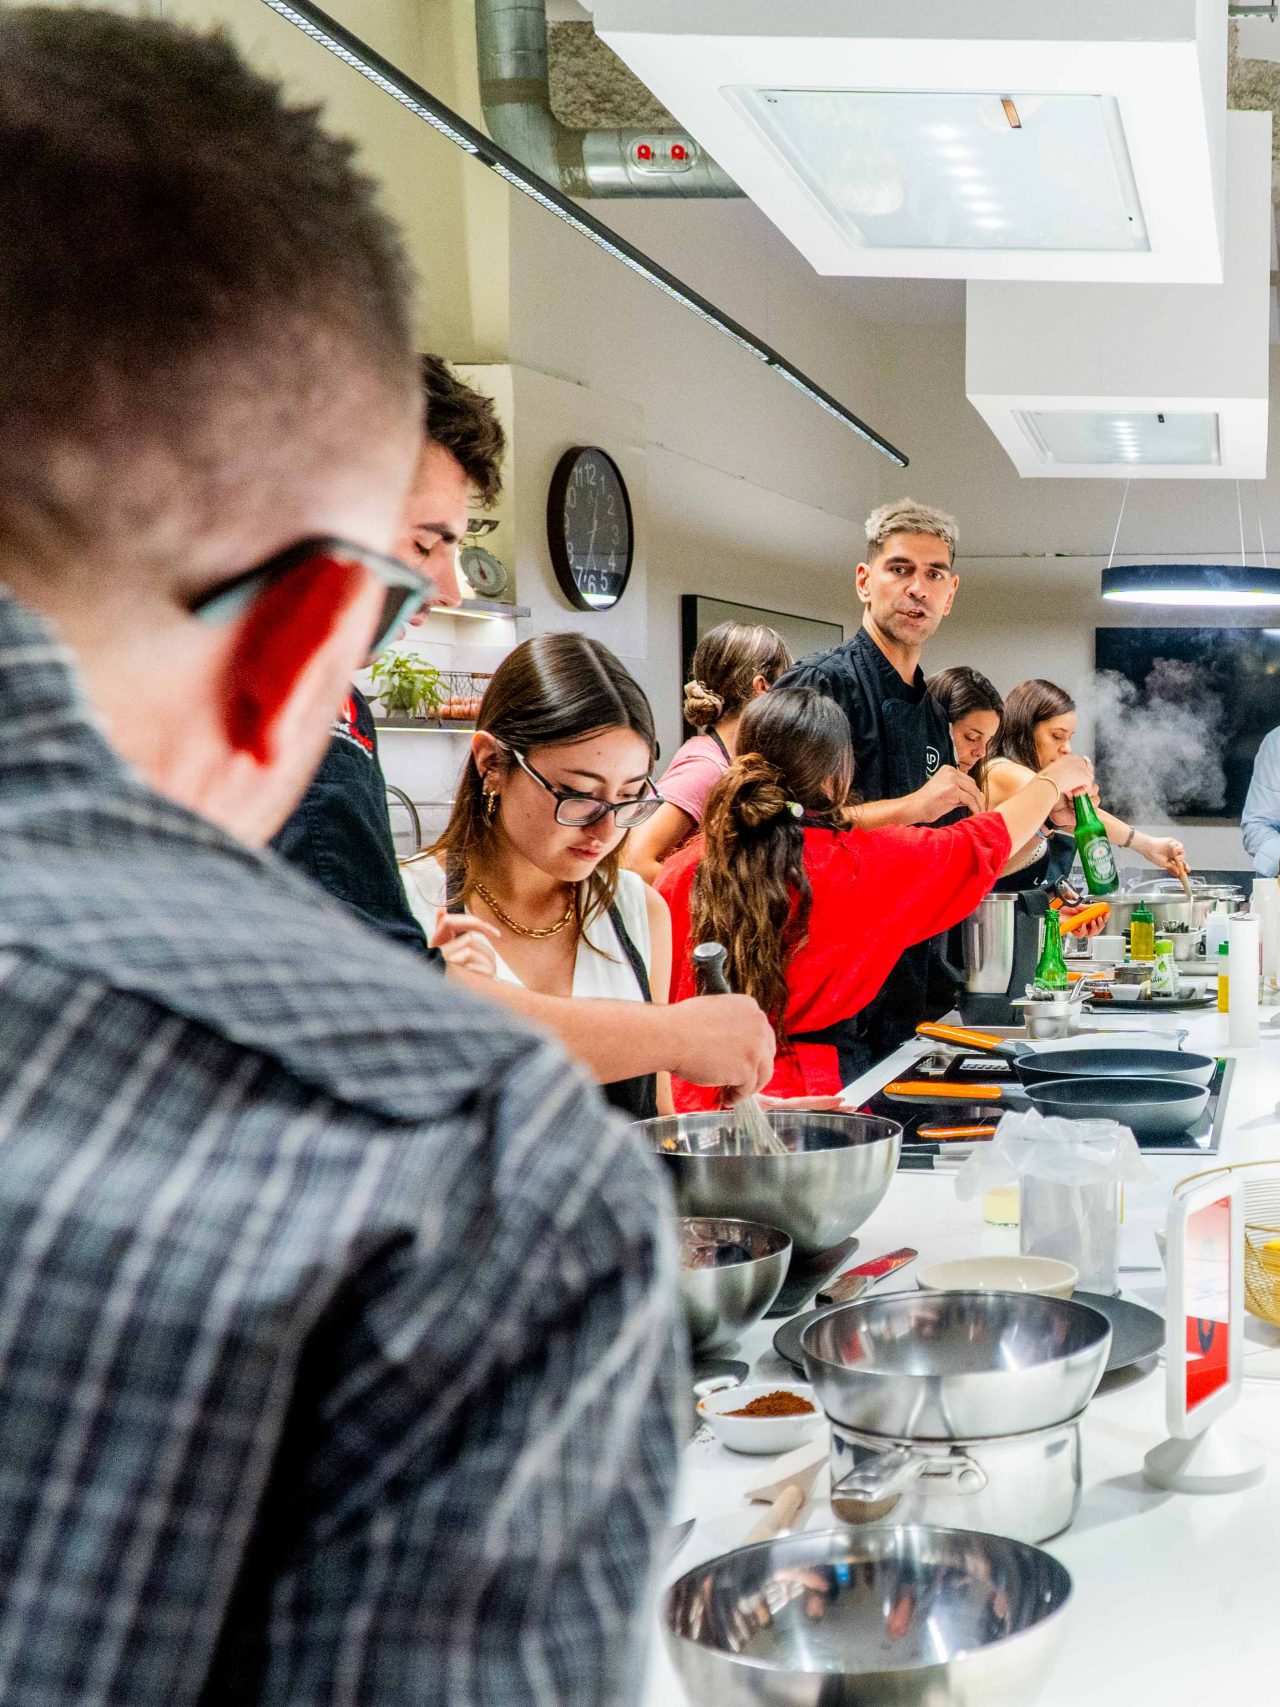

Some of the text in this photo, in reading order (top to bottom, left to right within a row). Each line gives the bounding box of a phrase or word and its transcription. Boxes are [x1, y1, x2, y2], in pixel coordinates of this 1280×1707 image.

[573, 465, 583, 488] 11
[584, 462, 596, 487] 12
[600, 475, 605, 495] 1
[608, 495, 615, 516] 2
[612, 525, 620, 545] 3
[608, 550, 616, 571] 4
[576, 565, 583, 588] 7
[587, 574, 597, 594] 6
[600, 569, 608, 591] 5
